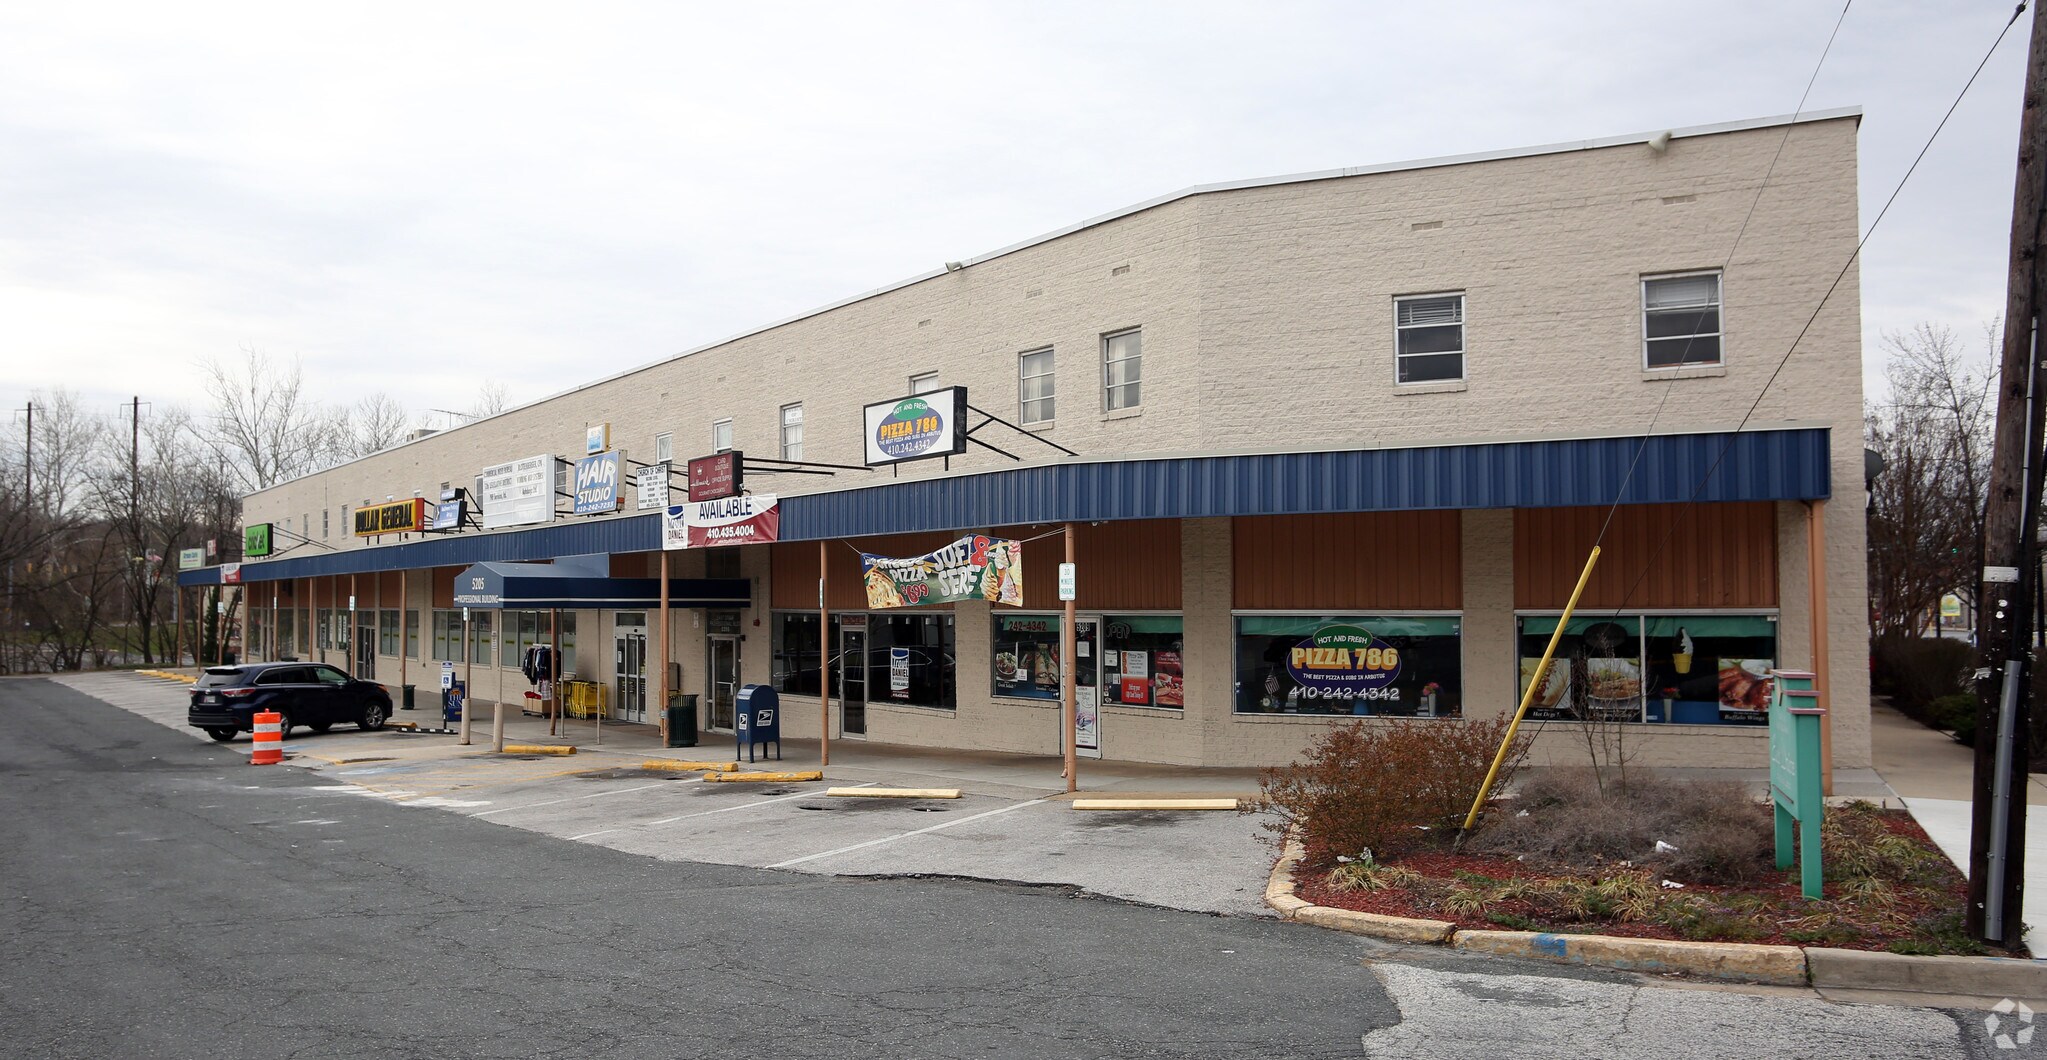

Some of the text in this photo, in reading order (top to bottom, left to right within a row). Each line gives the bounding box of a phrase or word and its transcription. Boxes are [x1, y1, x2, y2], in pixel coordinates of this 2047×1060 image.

[893, 405, 902, 415] HOT
[881, 416, 938, 440] PIZZA 786
[888, 439, 931, 455] 410.242.4342
[576, 459, 616, 495] HAIR
[577, 486, 610, 505] STUDIO
[699, 497, 752, 520] AVAILABLE
[356, 503, 413, 533] DOLLAR GENERAL
[707, 525, 754, 539] 410.435.4004
[970, 535, 990, 568] &
[890, 566, 928, 582] PIZZA
[472, 577, 484, 590] 5205
[457, 594, 499, 604] PROFESSIONAL BUILDING
[1008, 620, 1047, 632] 242-4342
[1317, 635, 1368, 644] HOT AND FRESH
[1291, 647, 1398, 670] PIZZA 786
[1303, 672, 1312, 680] THE
[1289, 686, 1400, 700] 410-242-4342
